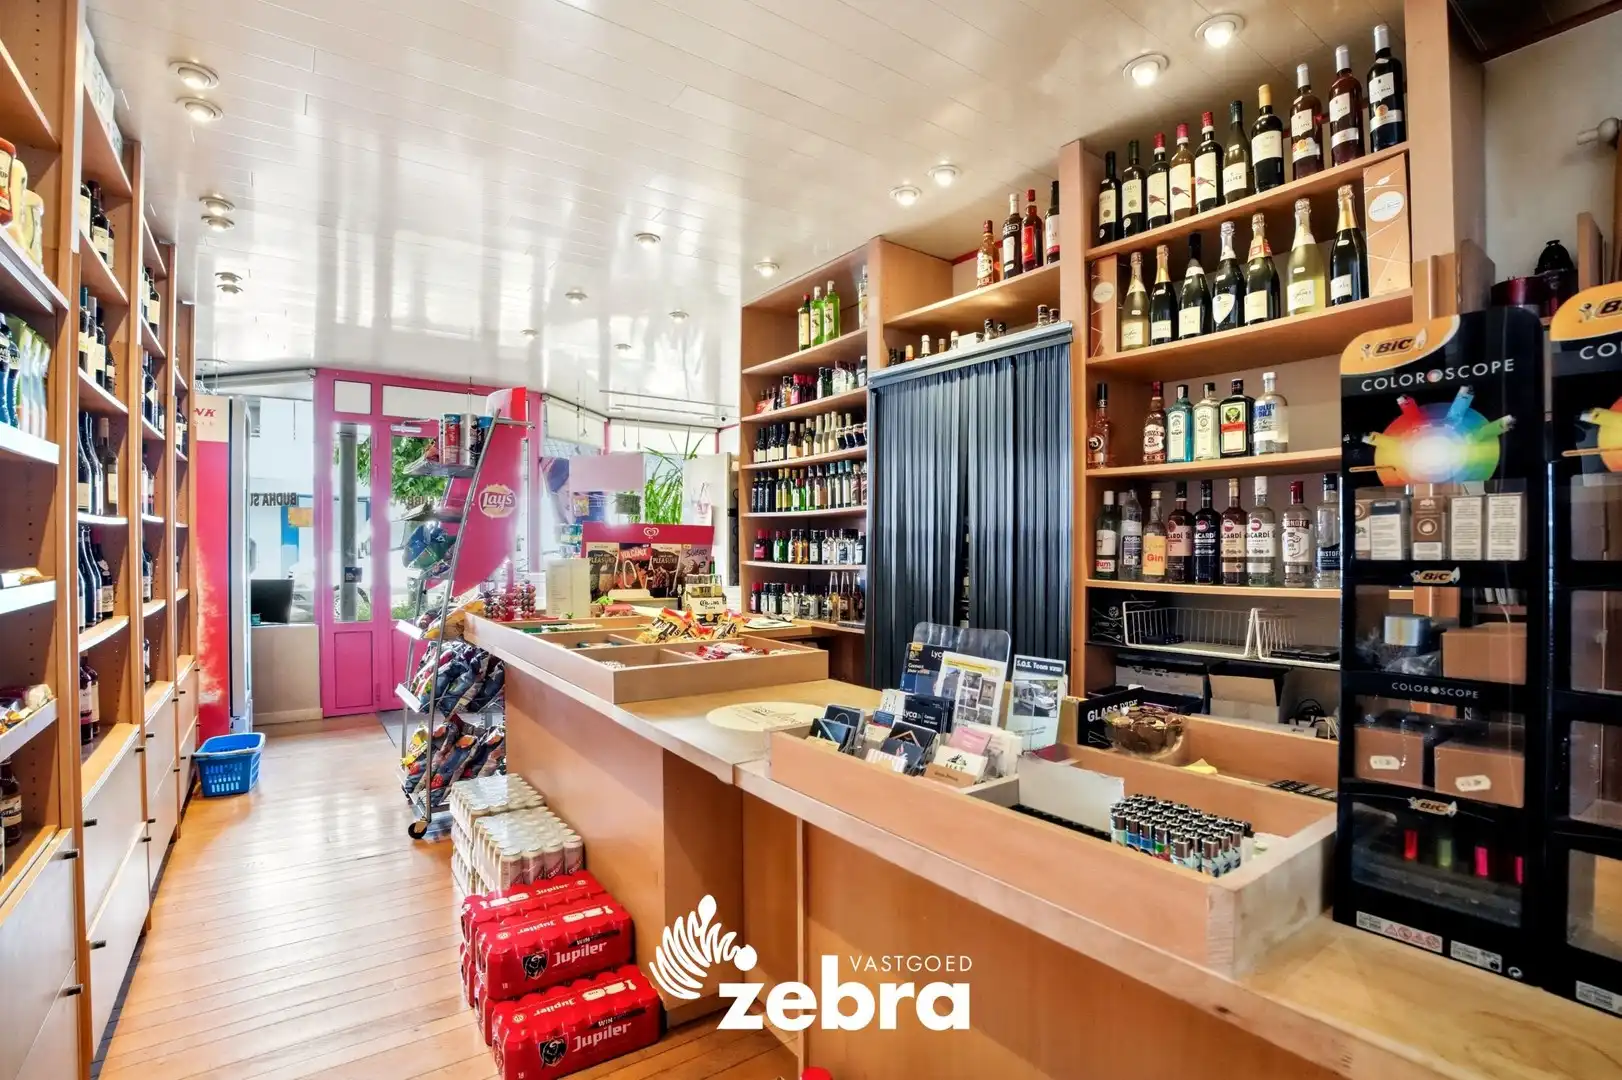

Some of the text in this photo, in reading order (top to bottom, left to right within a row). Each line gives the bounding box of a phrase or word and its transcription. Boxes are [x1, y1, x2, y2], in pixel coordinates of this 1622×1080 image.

[1600, 300, 1622, 314] B
[1375, 338, 1413, 354] BIC
[1147, 553, 1164, 562] Gin
[931, 650, 944, 659] Lyc
[552, 942, 607, 967] Jupiler
[572, 1022, 631, 1052] Jupiler
